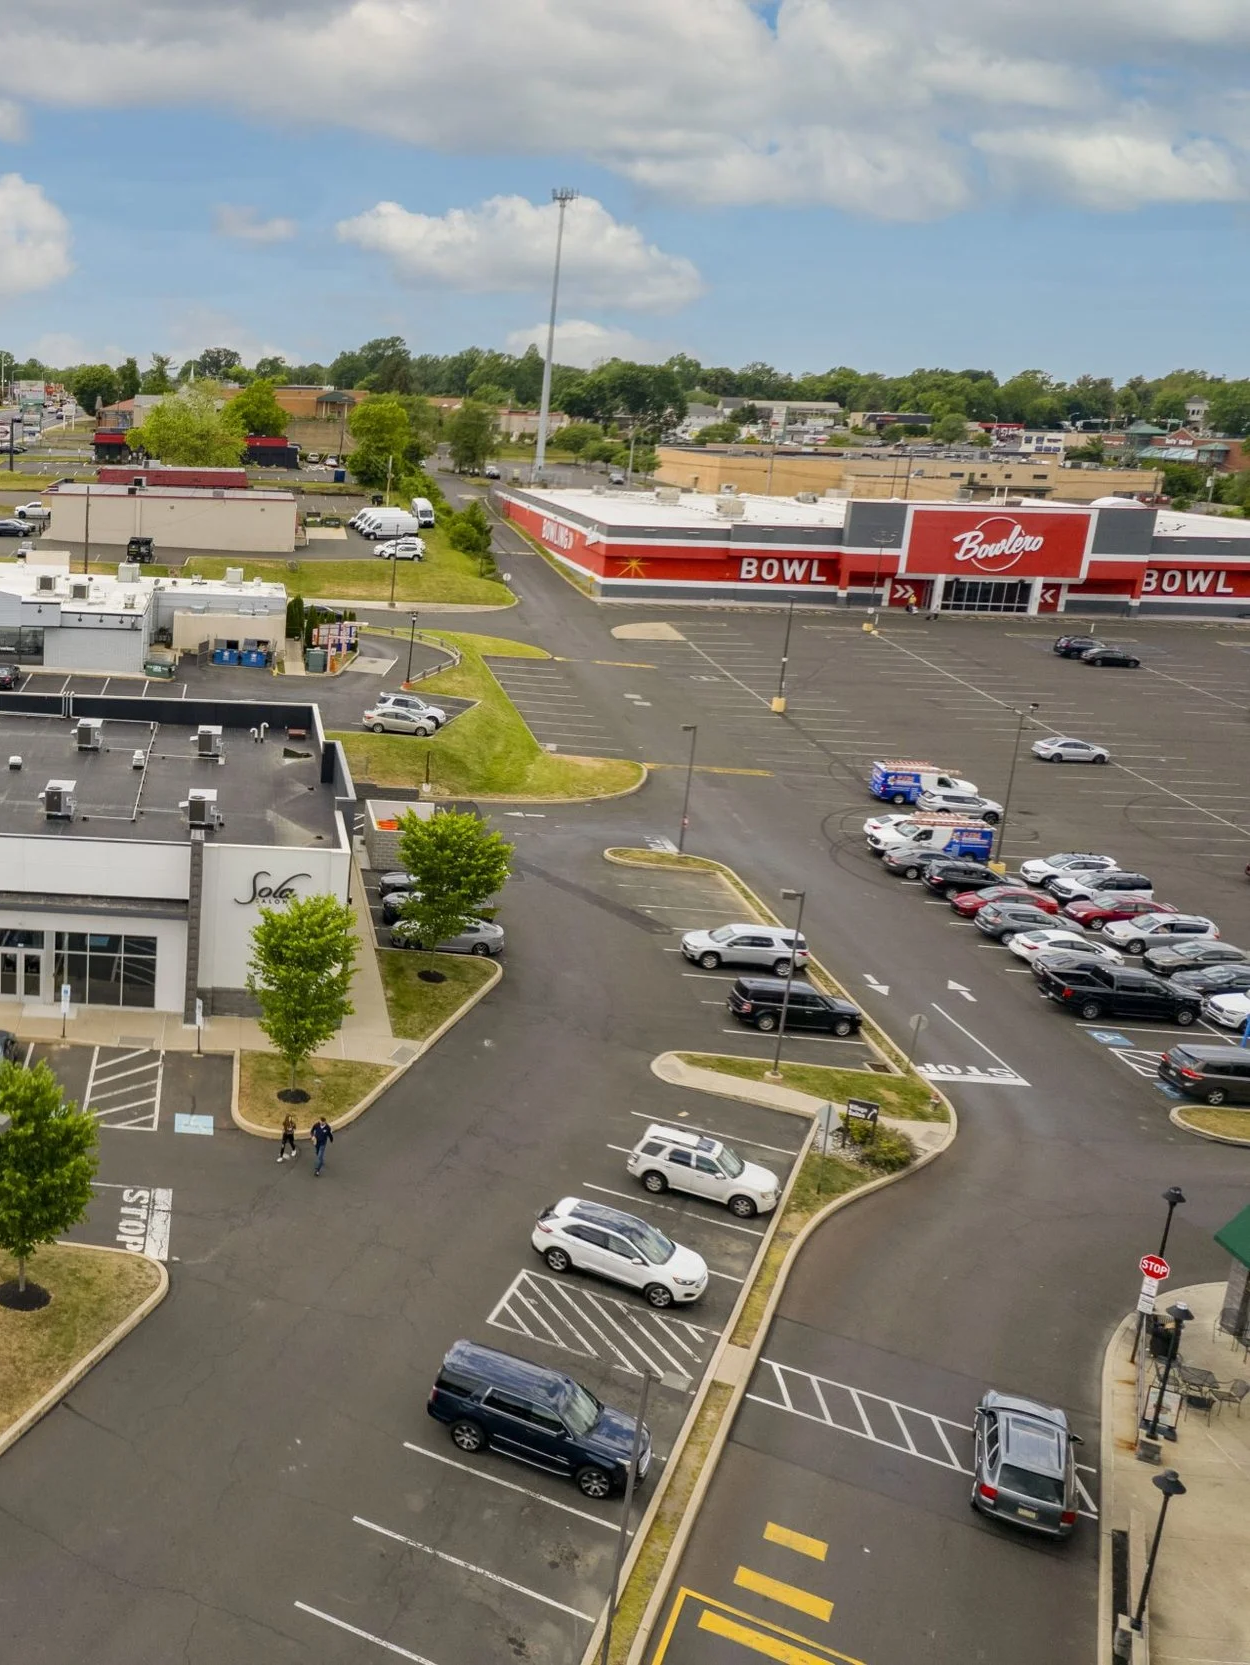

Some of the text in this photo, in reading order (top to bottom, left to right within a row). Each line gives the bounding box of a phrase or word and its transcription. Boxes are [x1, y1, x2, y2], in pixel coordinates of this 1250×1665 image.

[952, 524, 1044, 561] Bowlero
[740, 558, 827, 582] BOWL
[1141, 569, 1234, 593] BOWL
[234, 870, 312, 905] Sola
[916, 1062, 1016, 1078] STOP
[115, 1188, 150, 1252] STOP
[1141, 1259, 1168, 1275] STOP
